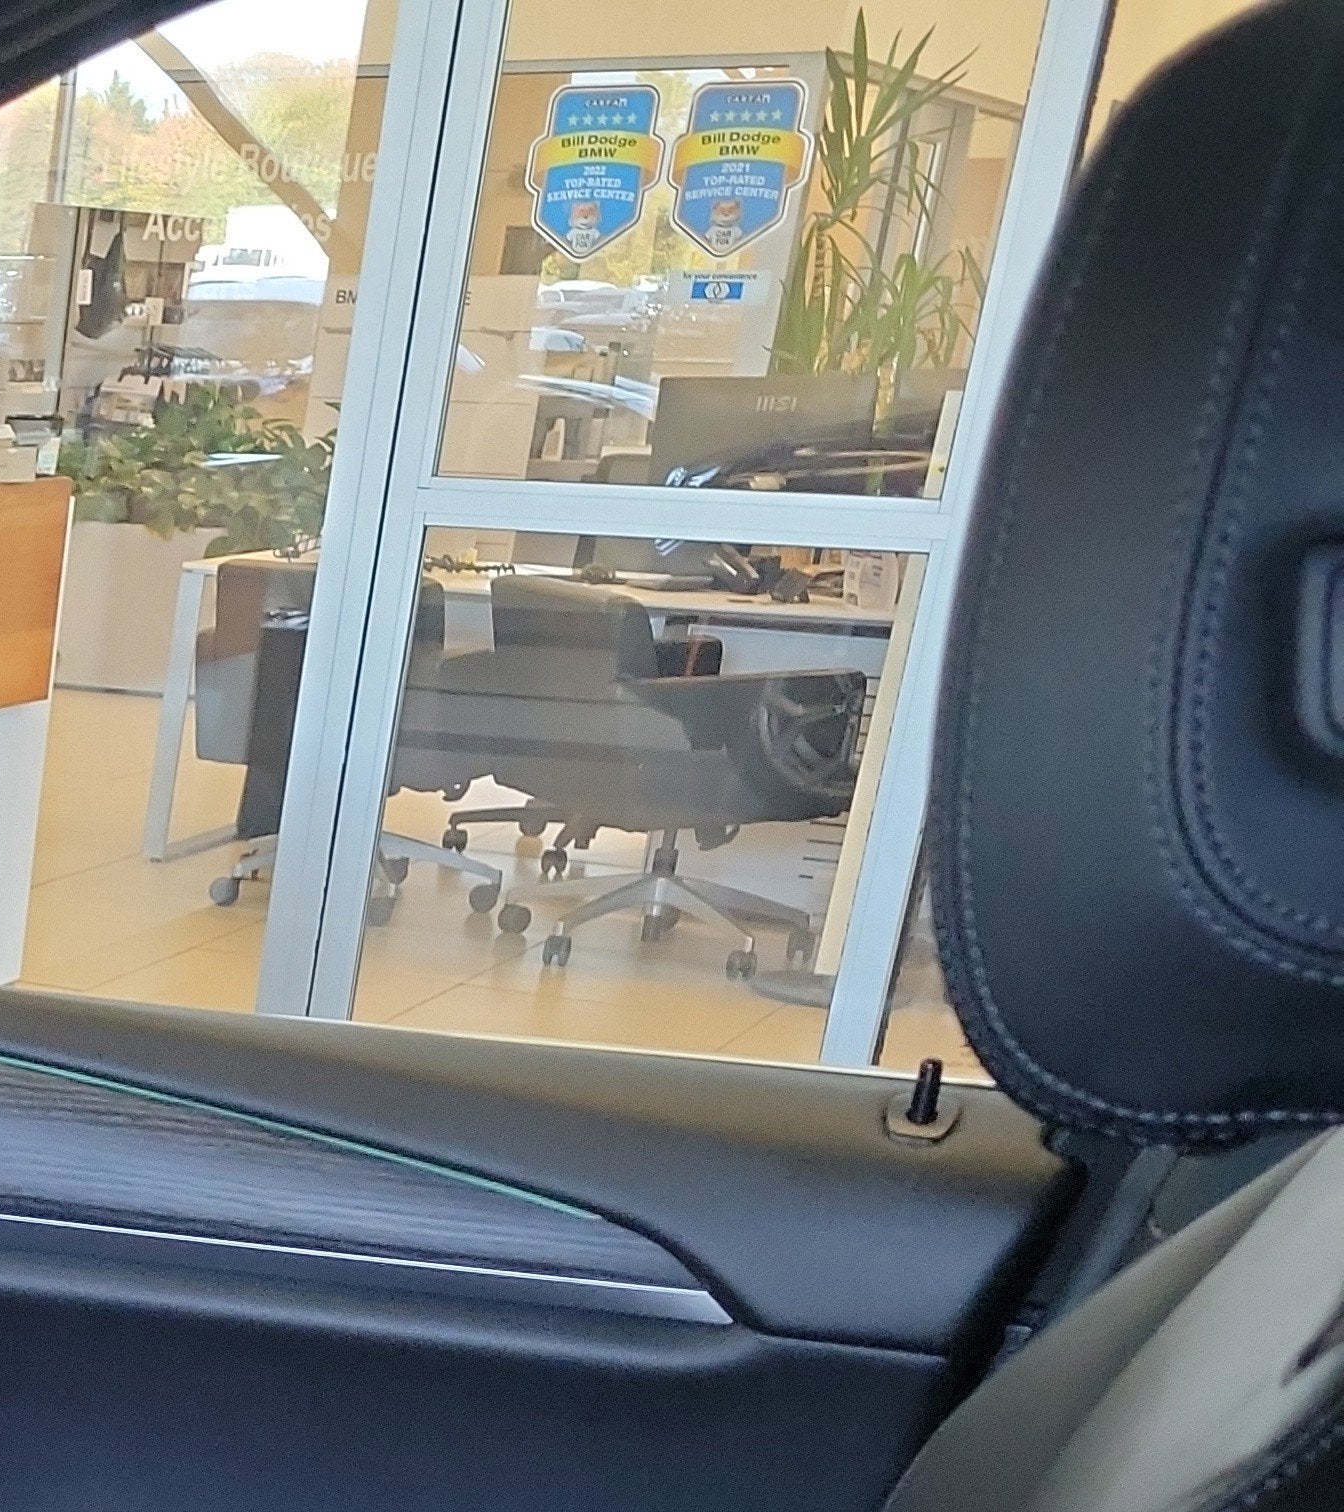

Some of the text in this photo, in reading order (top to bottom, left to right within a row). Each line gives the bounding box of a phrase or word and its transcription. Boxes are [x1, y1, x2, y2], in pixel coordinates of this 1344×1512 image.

[561, 133, 637, 149] Bill Dodge
[701, 132, 781, 147] Bill Dodge
[578, 147, 618, 158] BMW
[719, 146, 760, 156] BMW
[721, 163, 751, 174] 2021
[563, 177, 622, 190] TOP-RATED
[702, 175, 765, 187] TOP-RATED
[546, 187, 636, 203] SERVICE CENTER
[685, 185, 779, 200] SERVICE CENTER
[715, 230, 732, 239] CAR
